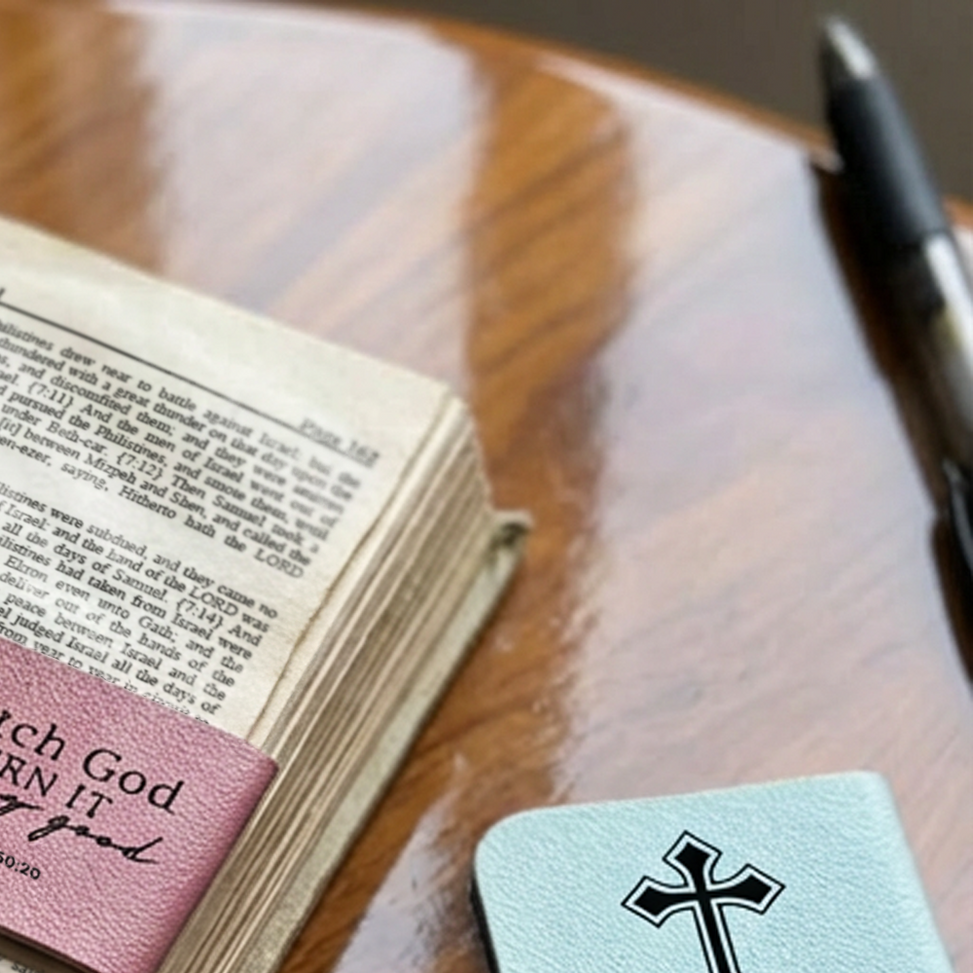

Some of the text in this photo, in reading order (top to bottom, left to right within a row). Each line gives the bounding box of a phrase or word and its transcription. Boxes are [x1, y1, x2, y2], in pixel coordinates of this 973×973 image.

[79, 403, 113, 424] And
[116, 419, 139, 436] the
[144, 432, 176, 452] men
[181, 449, 201, 463] of
[203, 456, 245, 483] Israel
[50, 508, 84, 529] were
[152, 554, 182, 573] and
[182, 567, 215, 589] they
[217, 585, 256, 608] came
[258, 603, 278, 619] no
[11, 614, 65, 643] judged
[65, 636, 109, 664] Israel
[111, 659, 133, 675] all
[135, 669, 159, 687] the
[162, 682, 196, 705] days
[200, 701, 220, 715] of
[66, 783, 114, 819] IT
[83, 747, 185, 814] God
[27, 814, 163, 864] good
